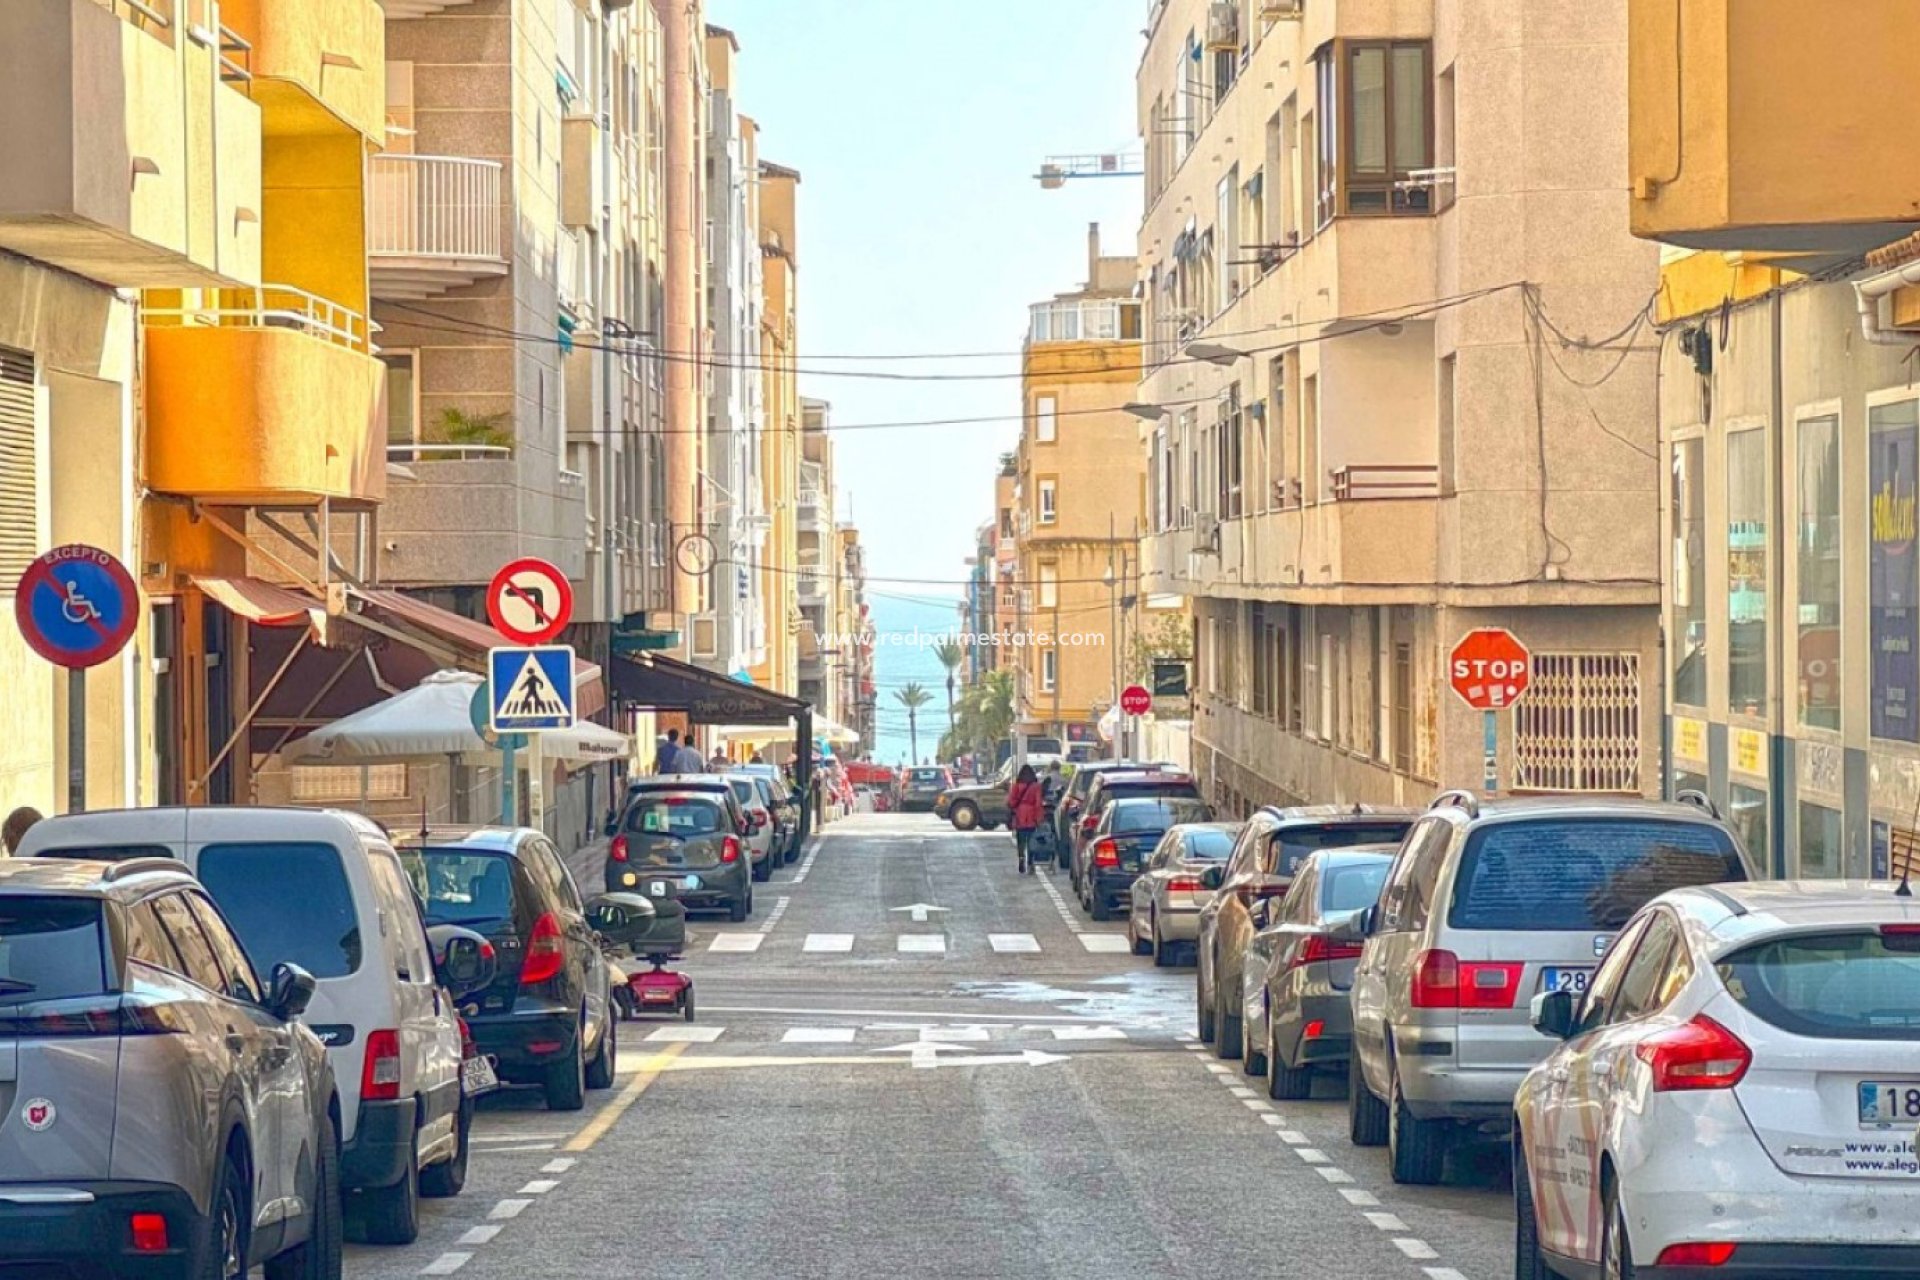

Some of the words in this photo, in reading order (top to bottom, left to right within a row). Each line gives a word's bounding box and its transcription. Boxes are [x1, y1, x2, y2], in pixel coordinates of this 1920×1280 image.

[44, 547, 110, 565] EXCEPTO
[1454, 660, 1525, 679] STOP
[1124, 696, 1148, 705] STOP
